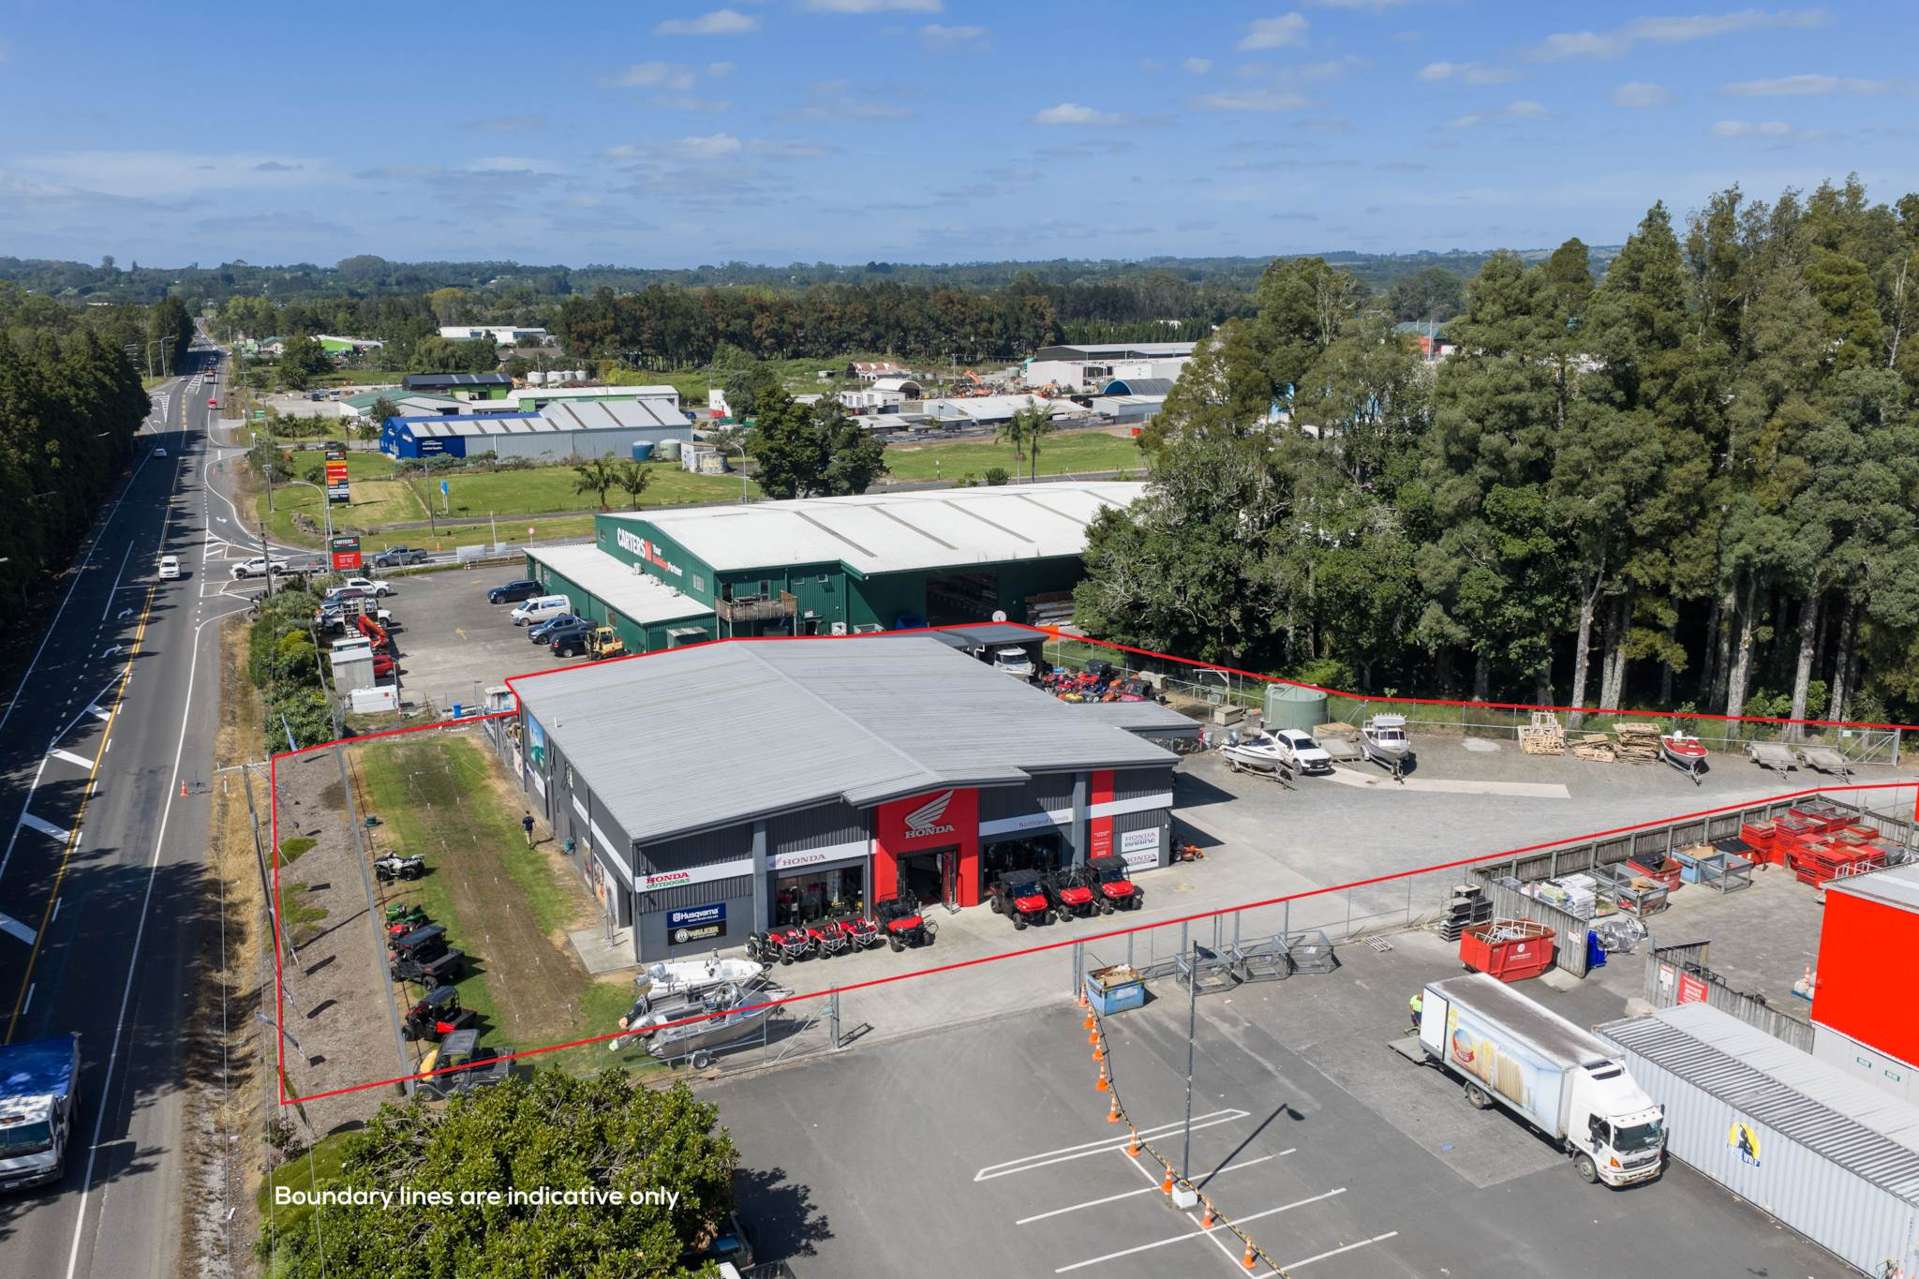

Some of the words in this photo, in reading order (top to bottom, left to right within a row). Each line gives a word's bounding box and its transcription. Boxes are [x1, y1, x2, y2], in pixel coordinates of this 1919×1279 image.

[617, 527, 646, 559] CARTERS
[905, 824, 955, 840] HONDA
[783, 853, 826, 867] HONDA
[647, 872, 689, 885] HONDA
[681, 908, 719, 921] Husqvarna
